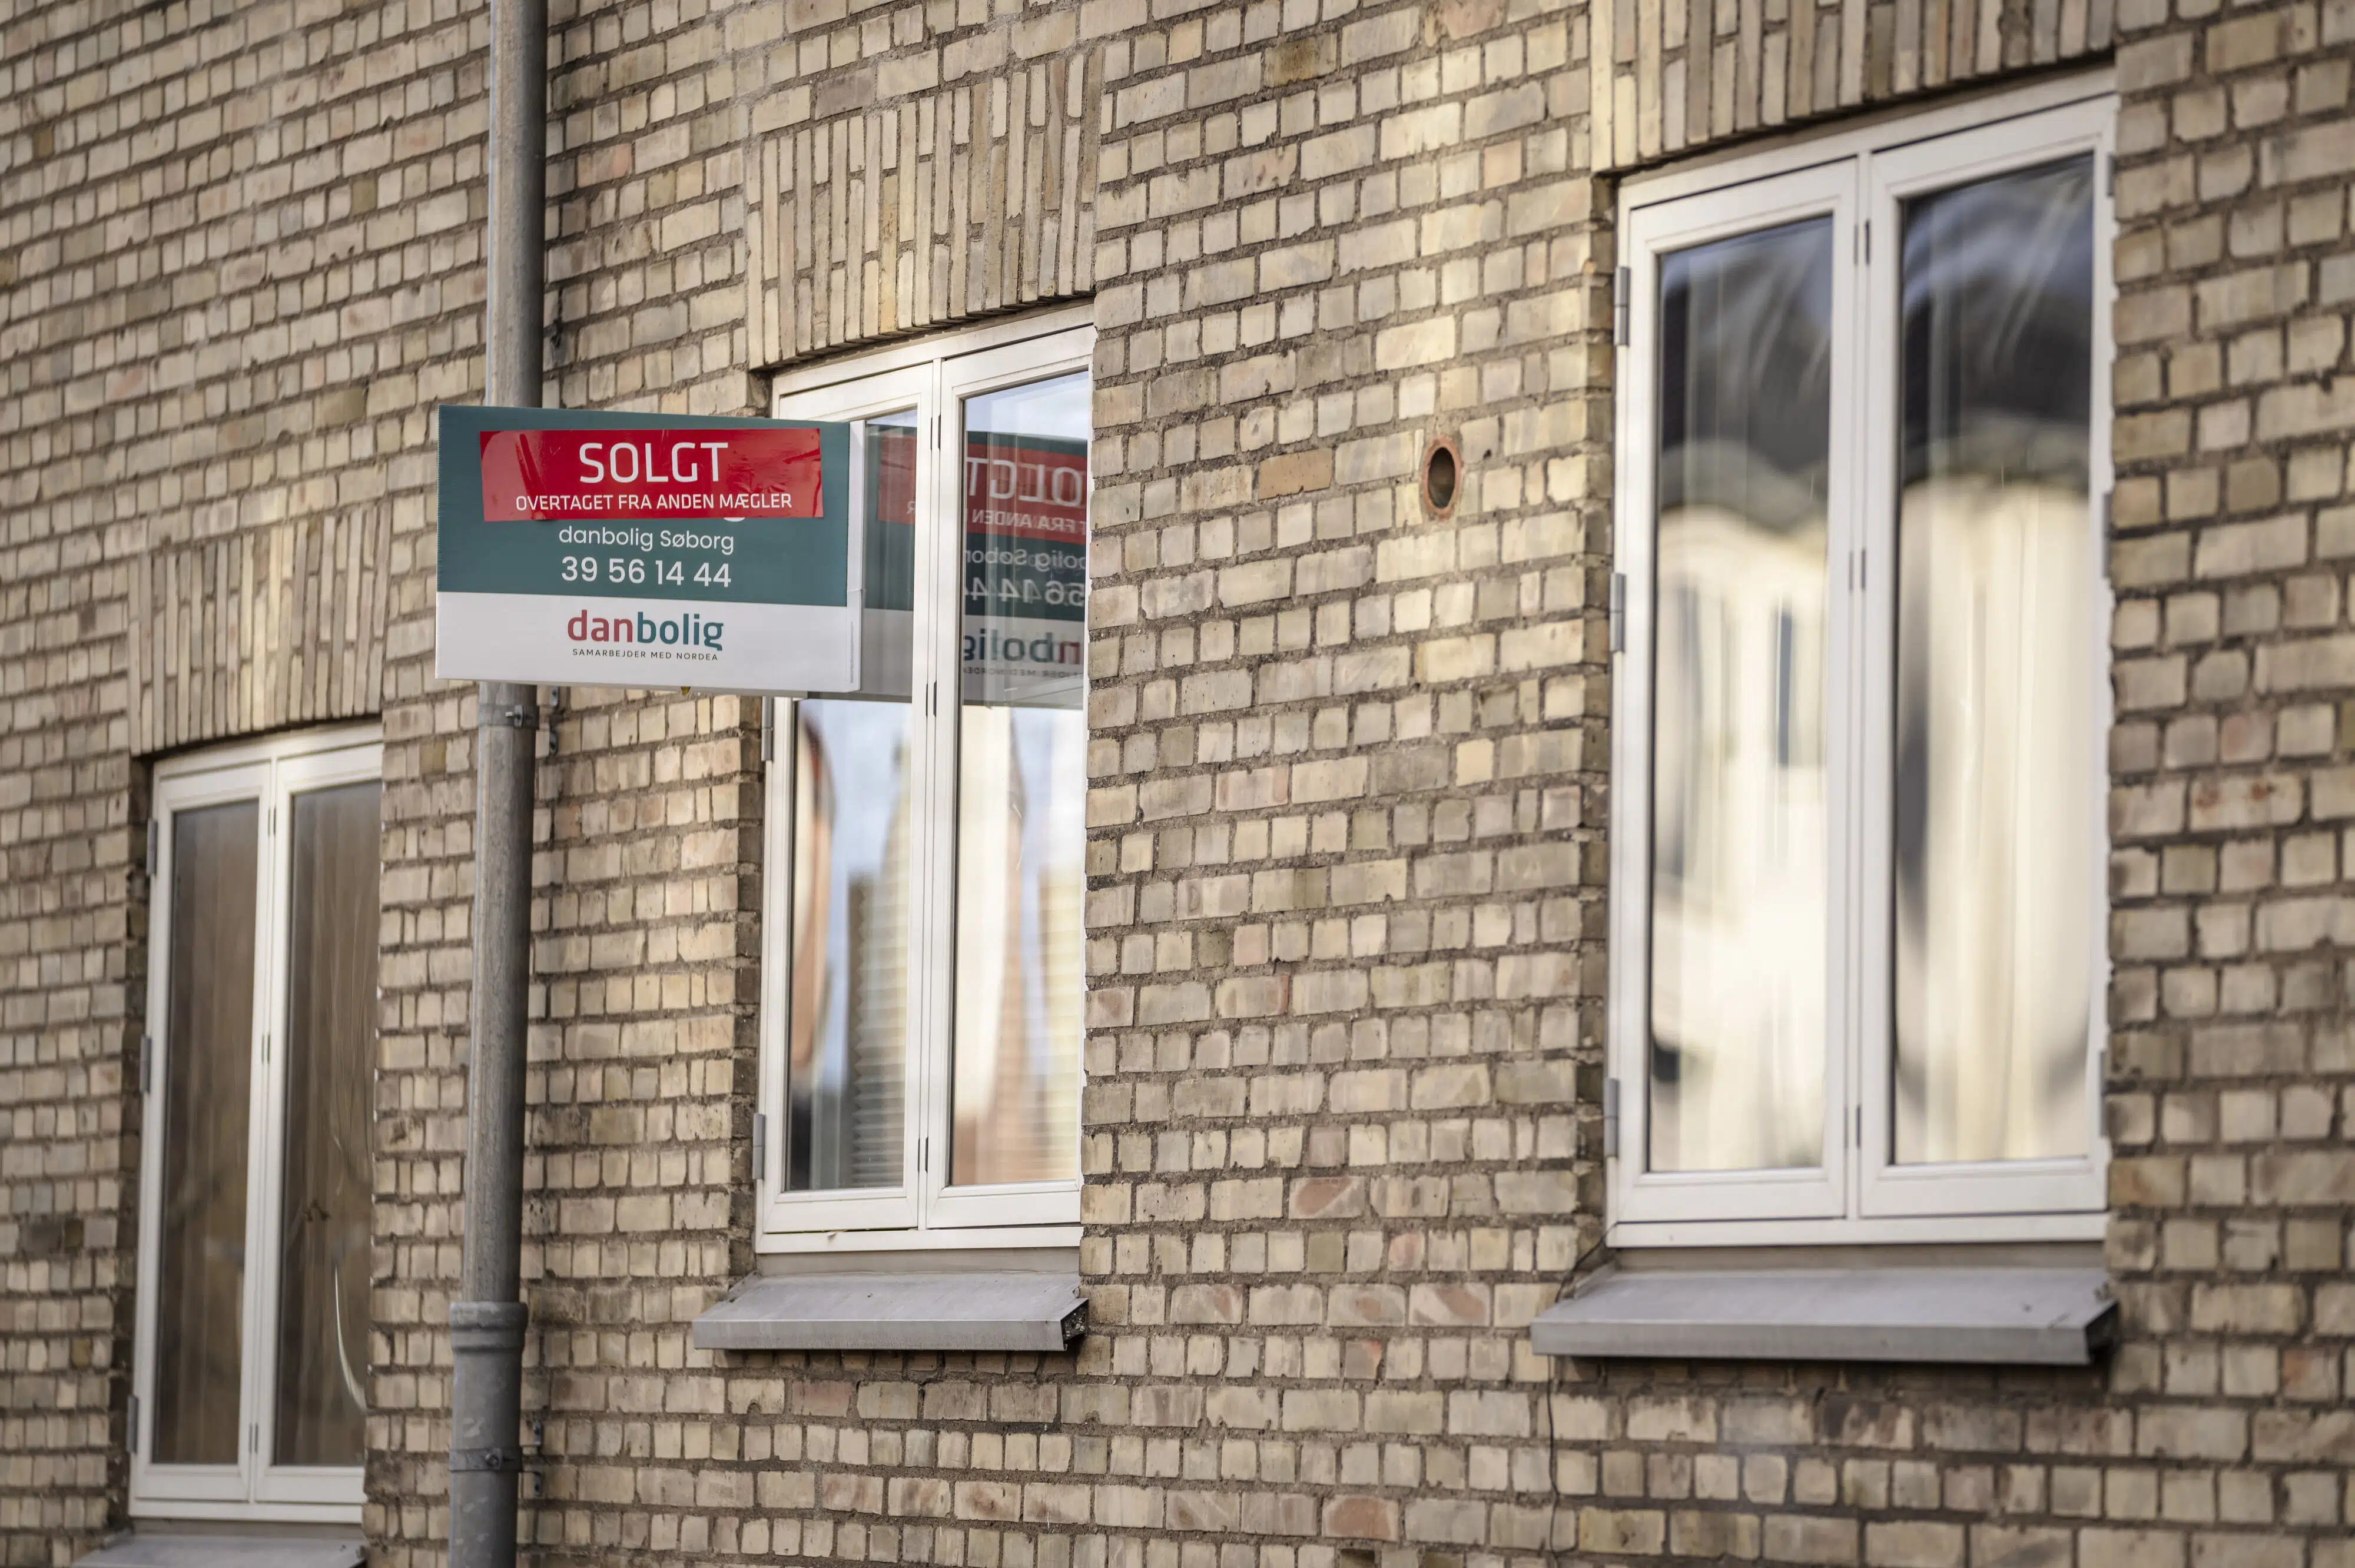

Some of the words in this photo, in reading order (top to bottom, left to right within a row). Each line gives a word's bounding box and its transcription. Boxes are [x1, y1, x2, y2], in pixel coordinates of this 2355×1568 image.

[579, 442, 729, 483] SOLGT
[516, 494, 613, 511] OVERTAGET
[618, 494, 652, 510] FRA
[656, 493, 714, 510] ANDEN
[719, 493, 792, 509] MÆGLER
[559, 525, 653, 552] danbolig
[660, 530, 734, 555] Søborg
[561, 556, 598, 582] 39
[609, 558, 645, 584] 56
[655, 560, 685, 586] 14
[694, 562, 731, 587] 44
[567, 609, 724, 651] danbolig
[572, 648, 646, 658] SAMARBEJDER
[676, 652, 718, 661] NORDEA
